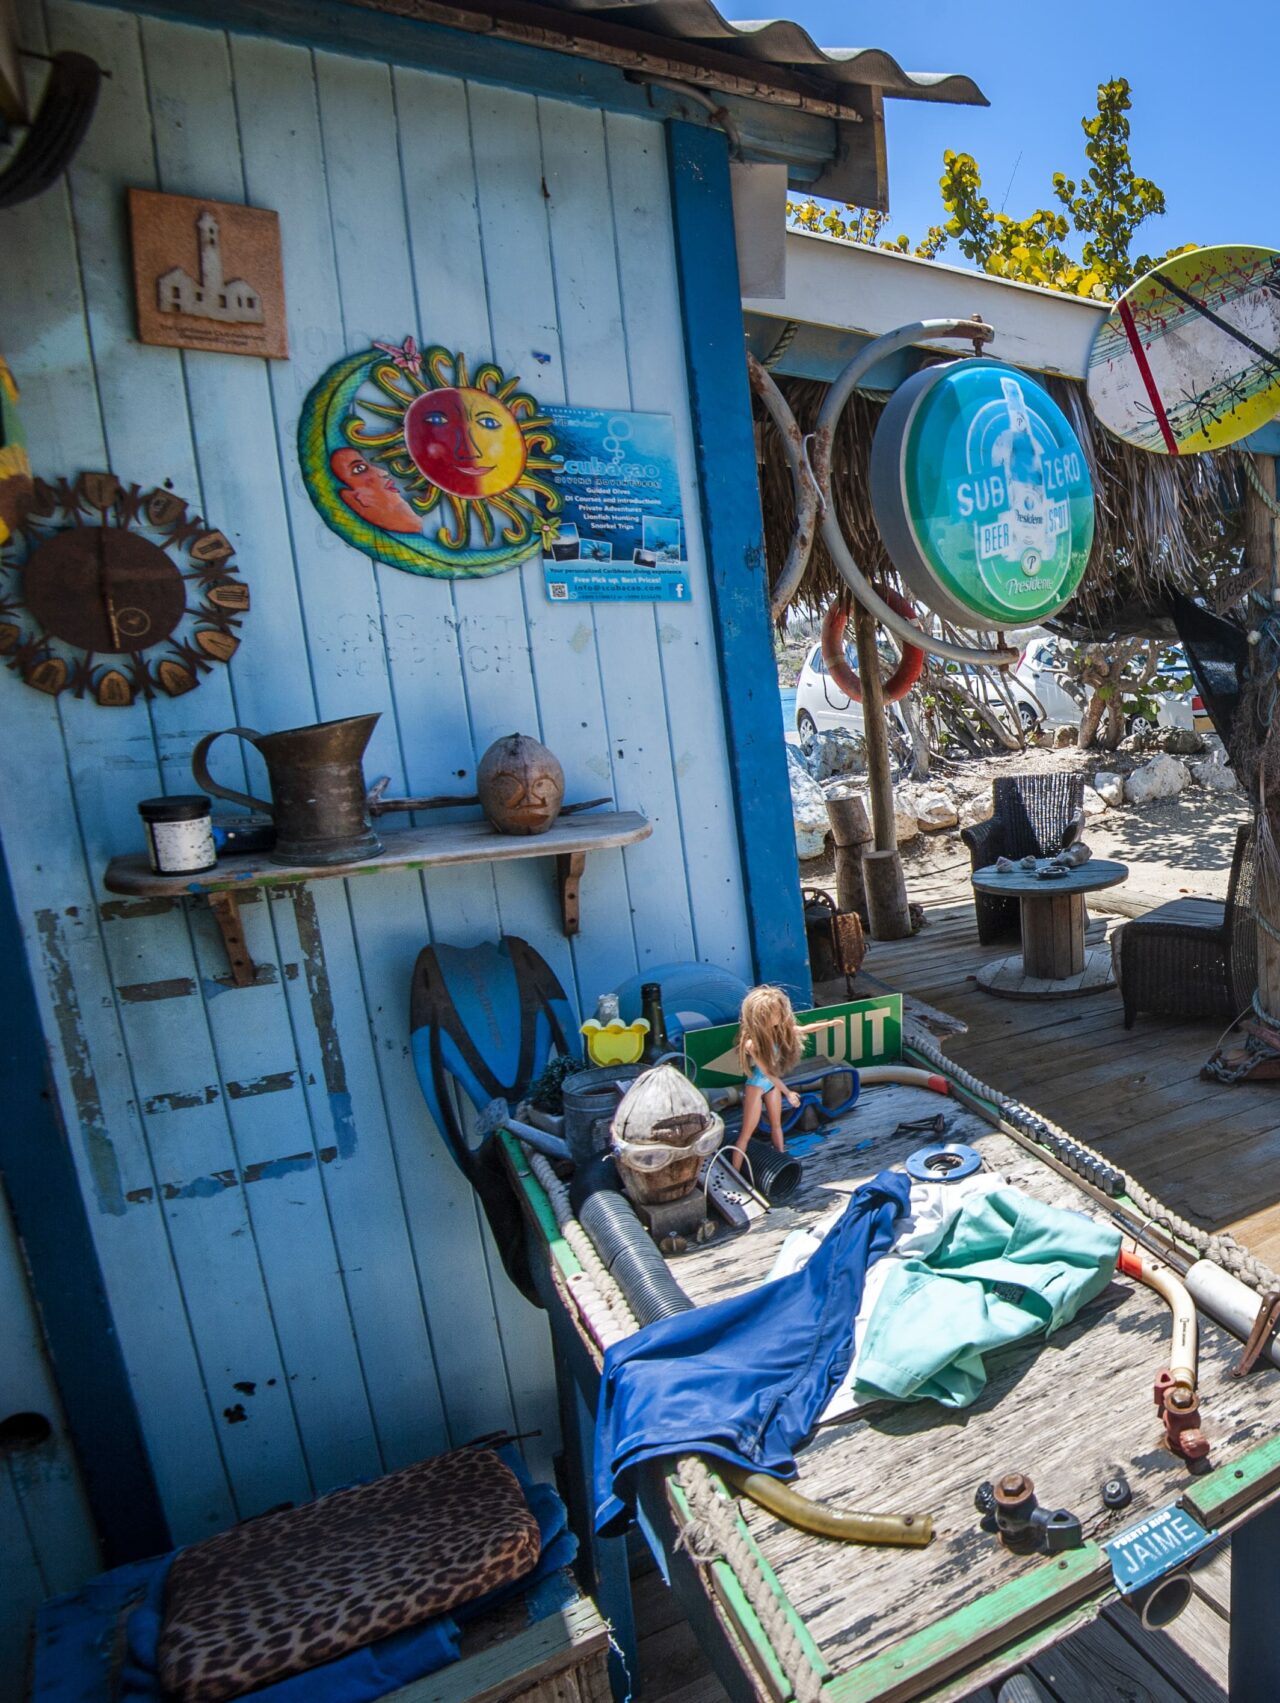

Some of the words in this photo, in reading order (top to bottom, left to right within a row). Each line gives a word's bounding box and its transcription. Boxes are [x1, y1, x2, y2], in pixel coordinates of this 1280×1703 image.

[586, 487, 611, 495] Guided
[957, 476, 1006, 517] SUB
[1043, 452, 1080, 491] ZERO
[578, 504, 603, 512] Private
[604, 505, 642, 513] Adventures
[583, 513, 611, 521] Lionfish
[612, 514, 639, 523] Hunting
[591, 522, 617, 530] Snorkel
[618, 523, 635, 531] Trips
[984, 522, 1010, 553] BEER
[1048, 503, 1069, 534] SPOT
[815, 1006, 892, 1063] UIT
[1112, 1524, 1150, 1550] PUERTO
[1148, 1510, 1172, 1529] RICO
[1122, 1516, 1198, 1574] JAIME
